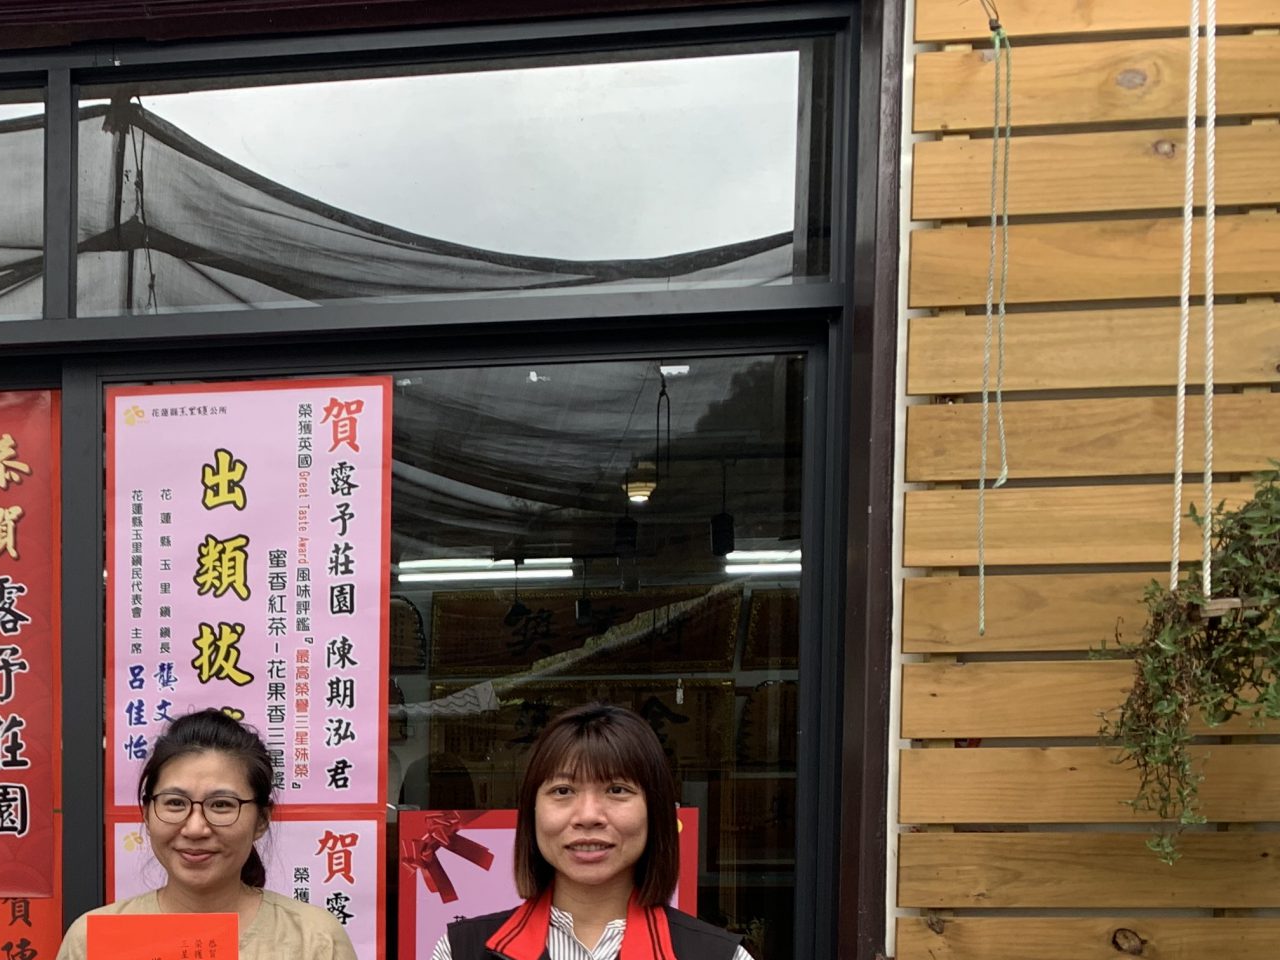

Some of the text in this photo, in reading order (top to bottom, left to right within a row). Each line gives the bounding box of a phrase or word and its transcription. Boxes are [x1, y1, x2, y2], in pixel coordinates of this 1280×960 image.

[320, 397, 365, 454] 賀
[192, 447, 256, 723] 出類拔
[324, 635, 360, 791] 陳期泓君
[314, 829, 359, 885] 賀
